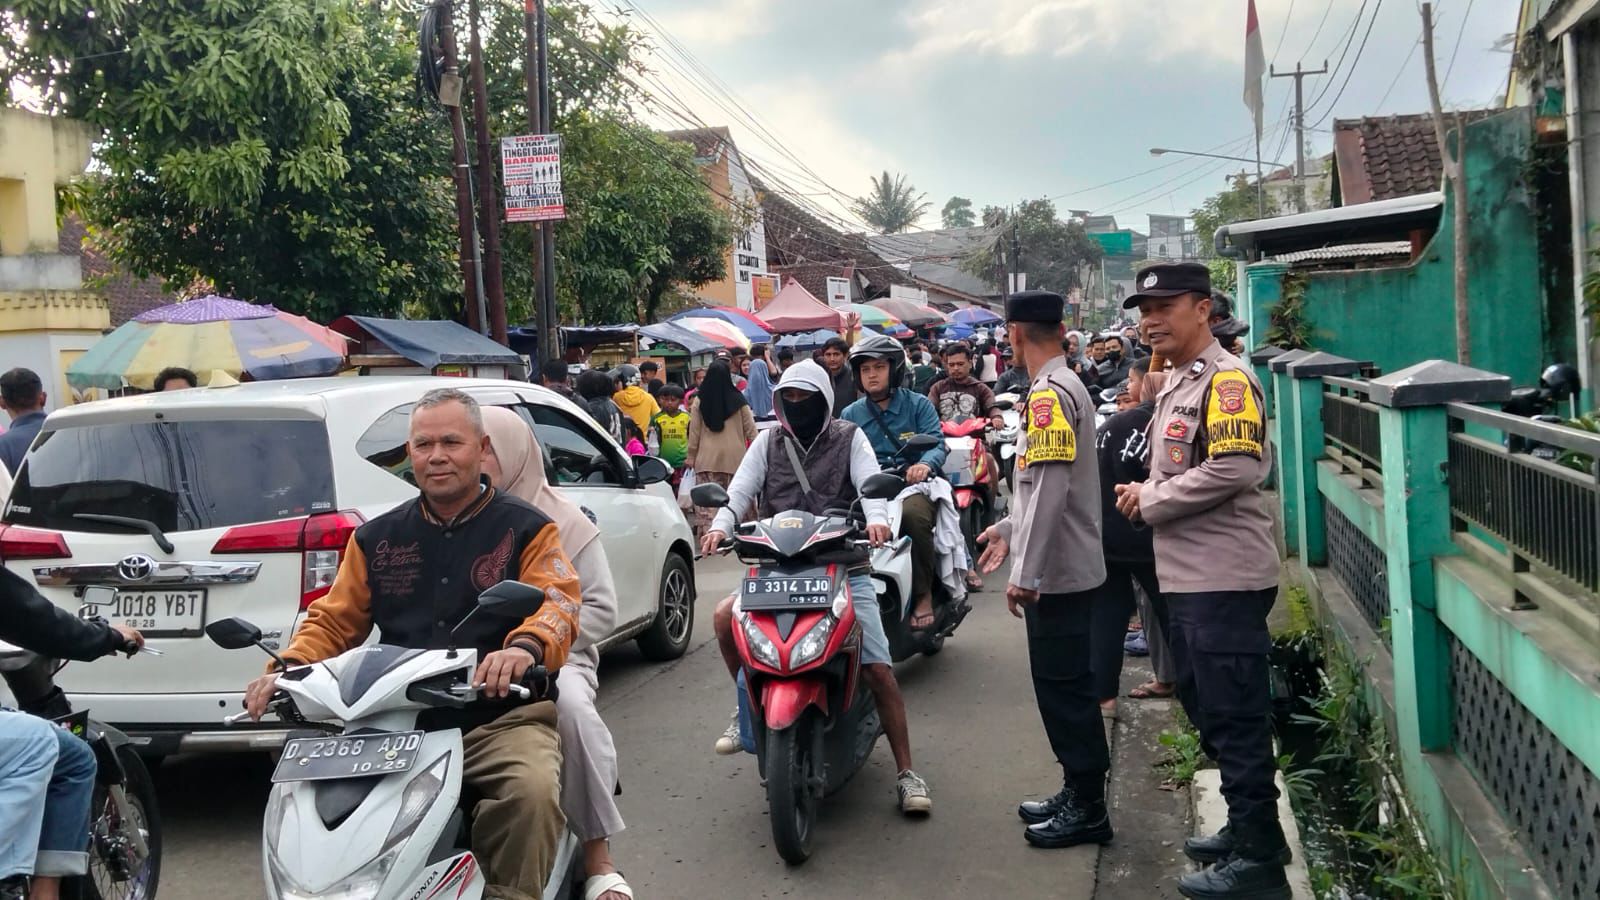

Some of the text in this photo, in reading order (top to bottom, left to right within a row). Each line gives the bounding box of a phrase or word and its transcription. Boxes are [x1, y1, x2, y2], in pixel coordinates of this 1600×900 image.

[504, 146, 559, 158] TINGGI BADAN
[505, 156, 558, 165] BANDUNG
[1171, 405, 1199, 417] POLRI
[748, 581, 757, 593] B
[764, 581, 798, 593] 3314
[112, 595, 156, 617] 1018
[164, 594, 198, 616] YBT
[285, 743, 299, 759] D
[309, 739, 365, 758] 2368
